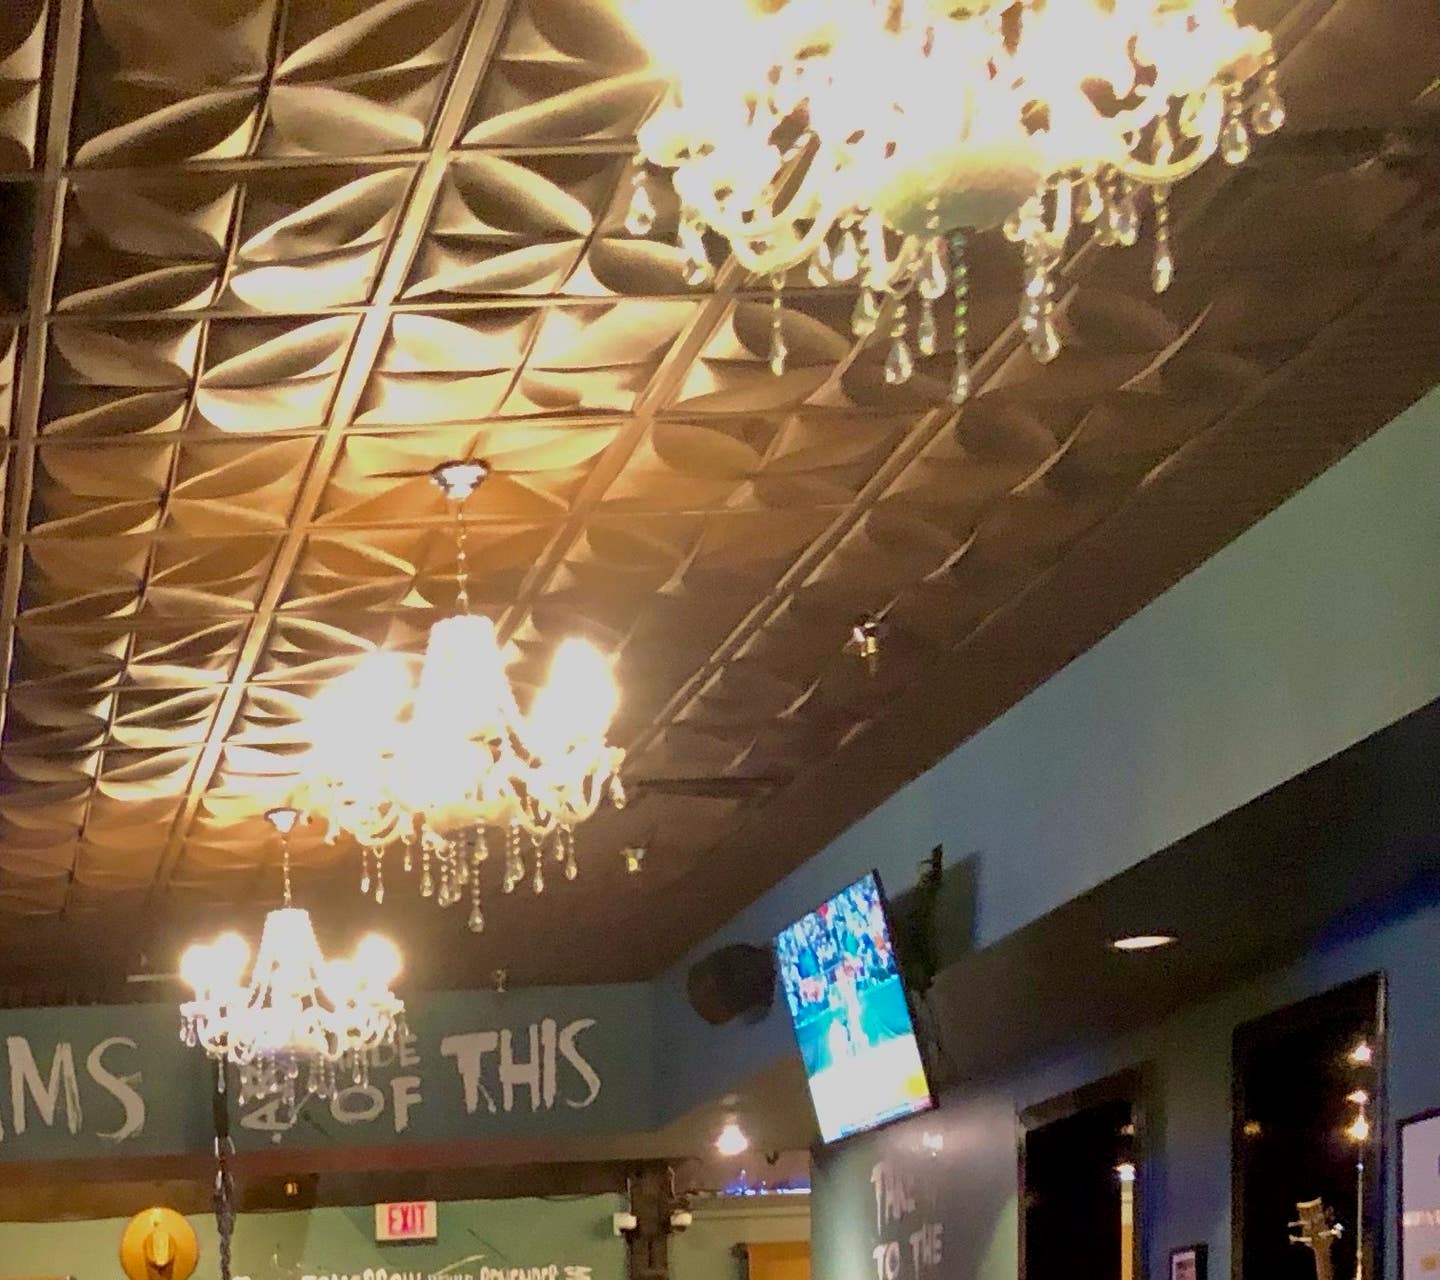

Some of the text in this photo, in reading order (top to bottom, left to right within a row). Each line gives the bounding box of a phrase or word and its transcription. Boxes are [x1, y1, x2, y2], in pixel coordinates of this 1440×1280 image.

[329, 1076, 423, 1133] OF
[440, 1018, 601, 1113] THIS
[387, 1203, 427, 1237] EXIT
